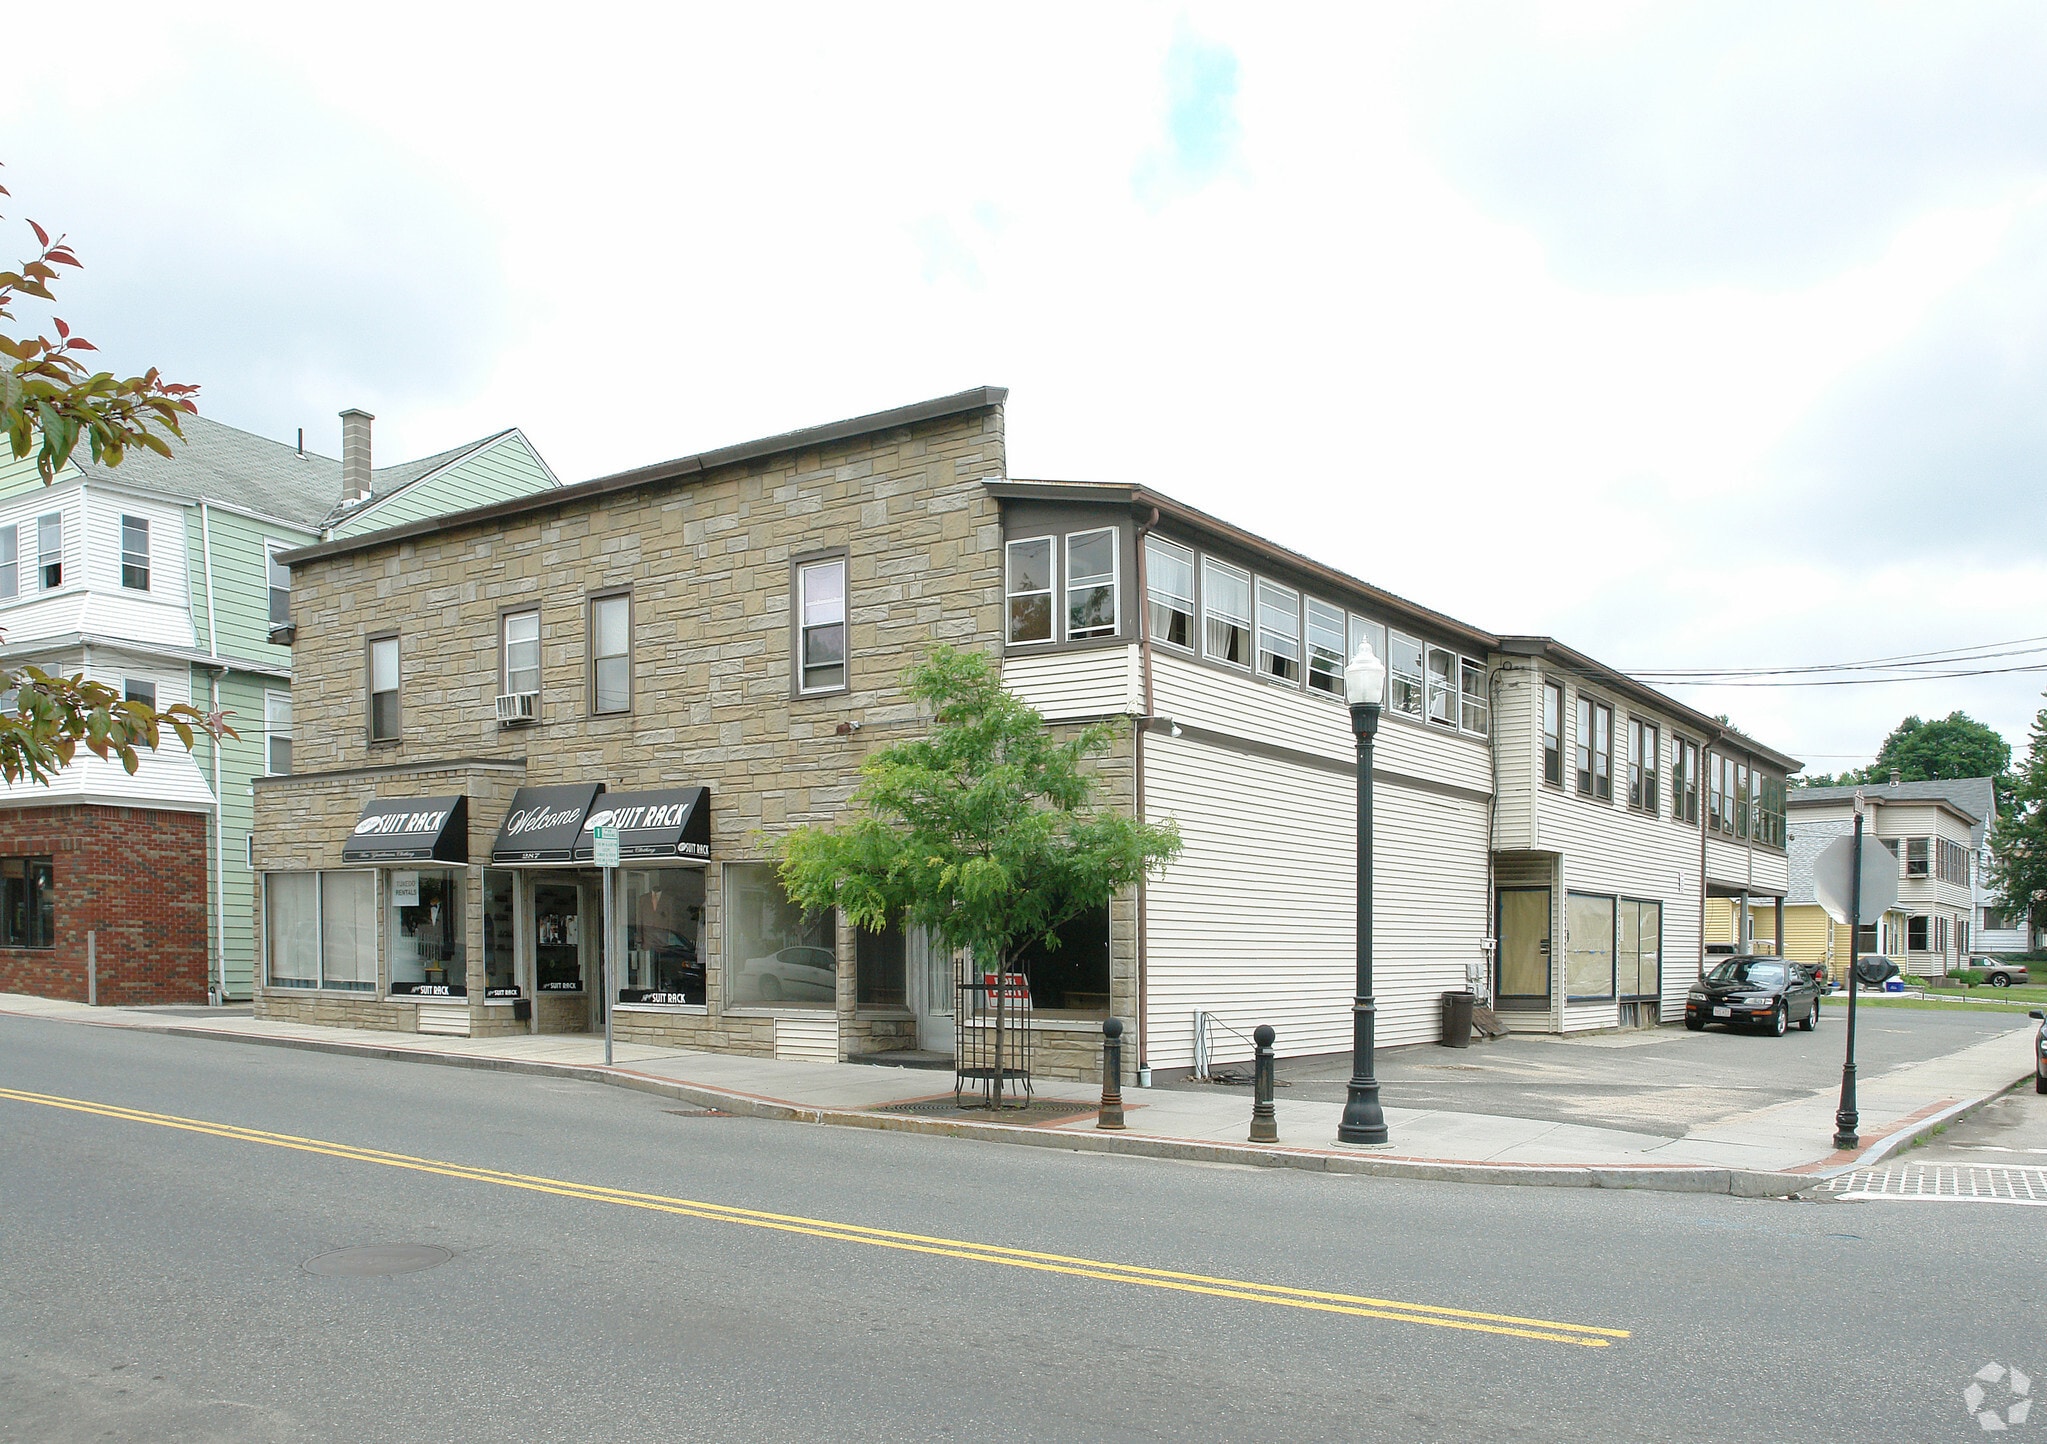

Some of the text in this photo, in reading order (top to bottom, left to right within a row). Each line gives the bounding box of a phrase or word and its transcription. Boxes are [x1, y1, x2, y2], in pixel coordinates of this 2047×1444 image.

[373, 812, 410, 834] SUIT
[404, 810, 447, 832] RACK
[507, 805, 581, 837] Welcome
[607, 806, 646, 829] SUIT
[641, 803, 689, 827] RACK
[685, 842, 710, 855] SUIT RACK
[420, 985, 432, 995] SUIT
[433, 985, 449, 995] RACK
[652, 992, 667, 1003] SUIT
[667, 992, 686, 1003] RACK
